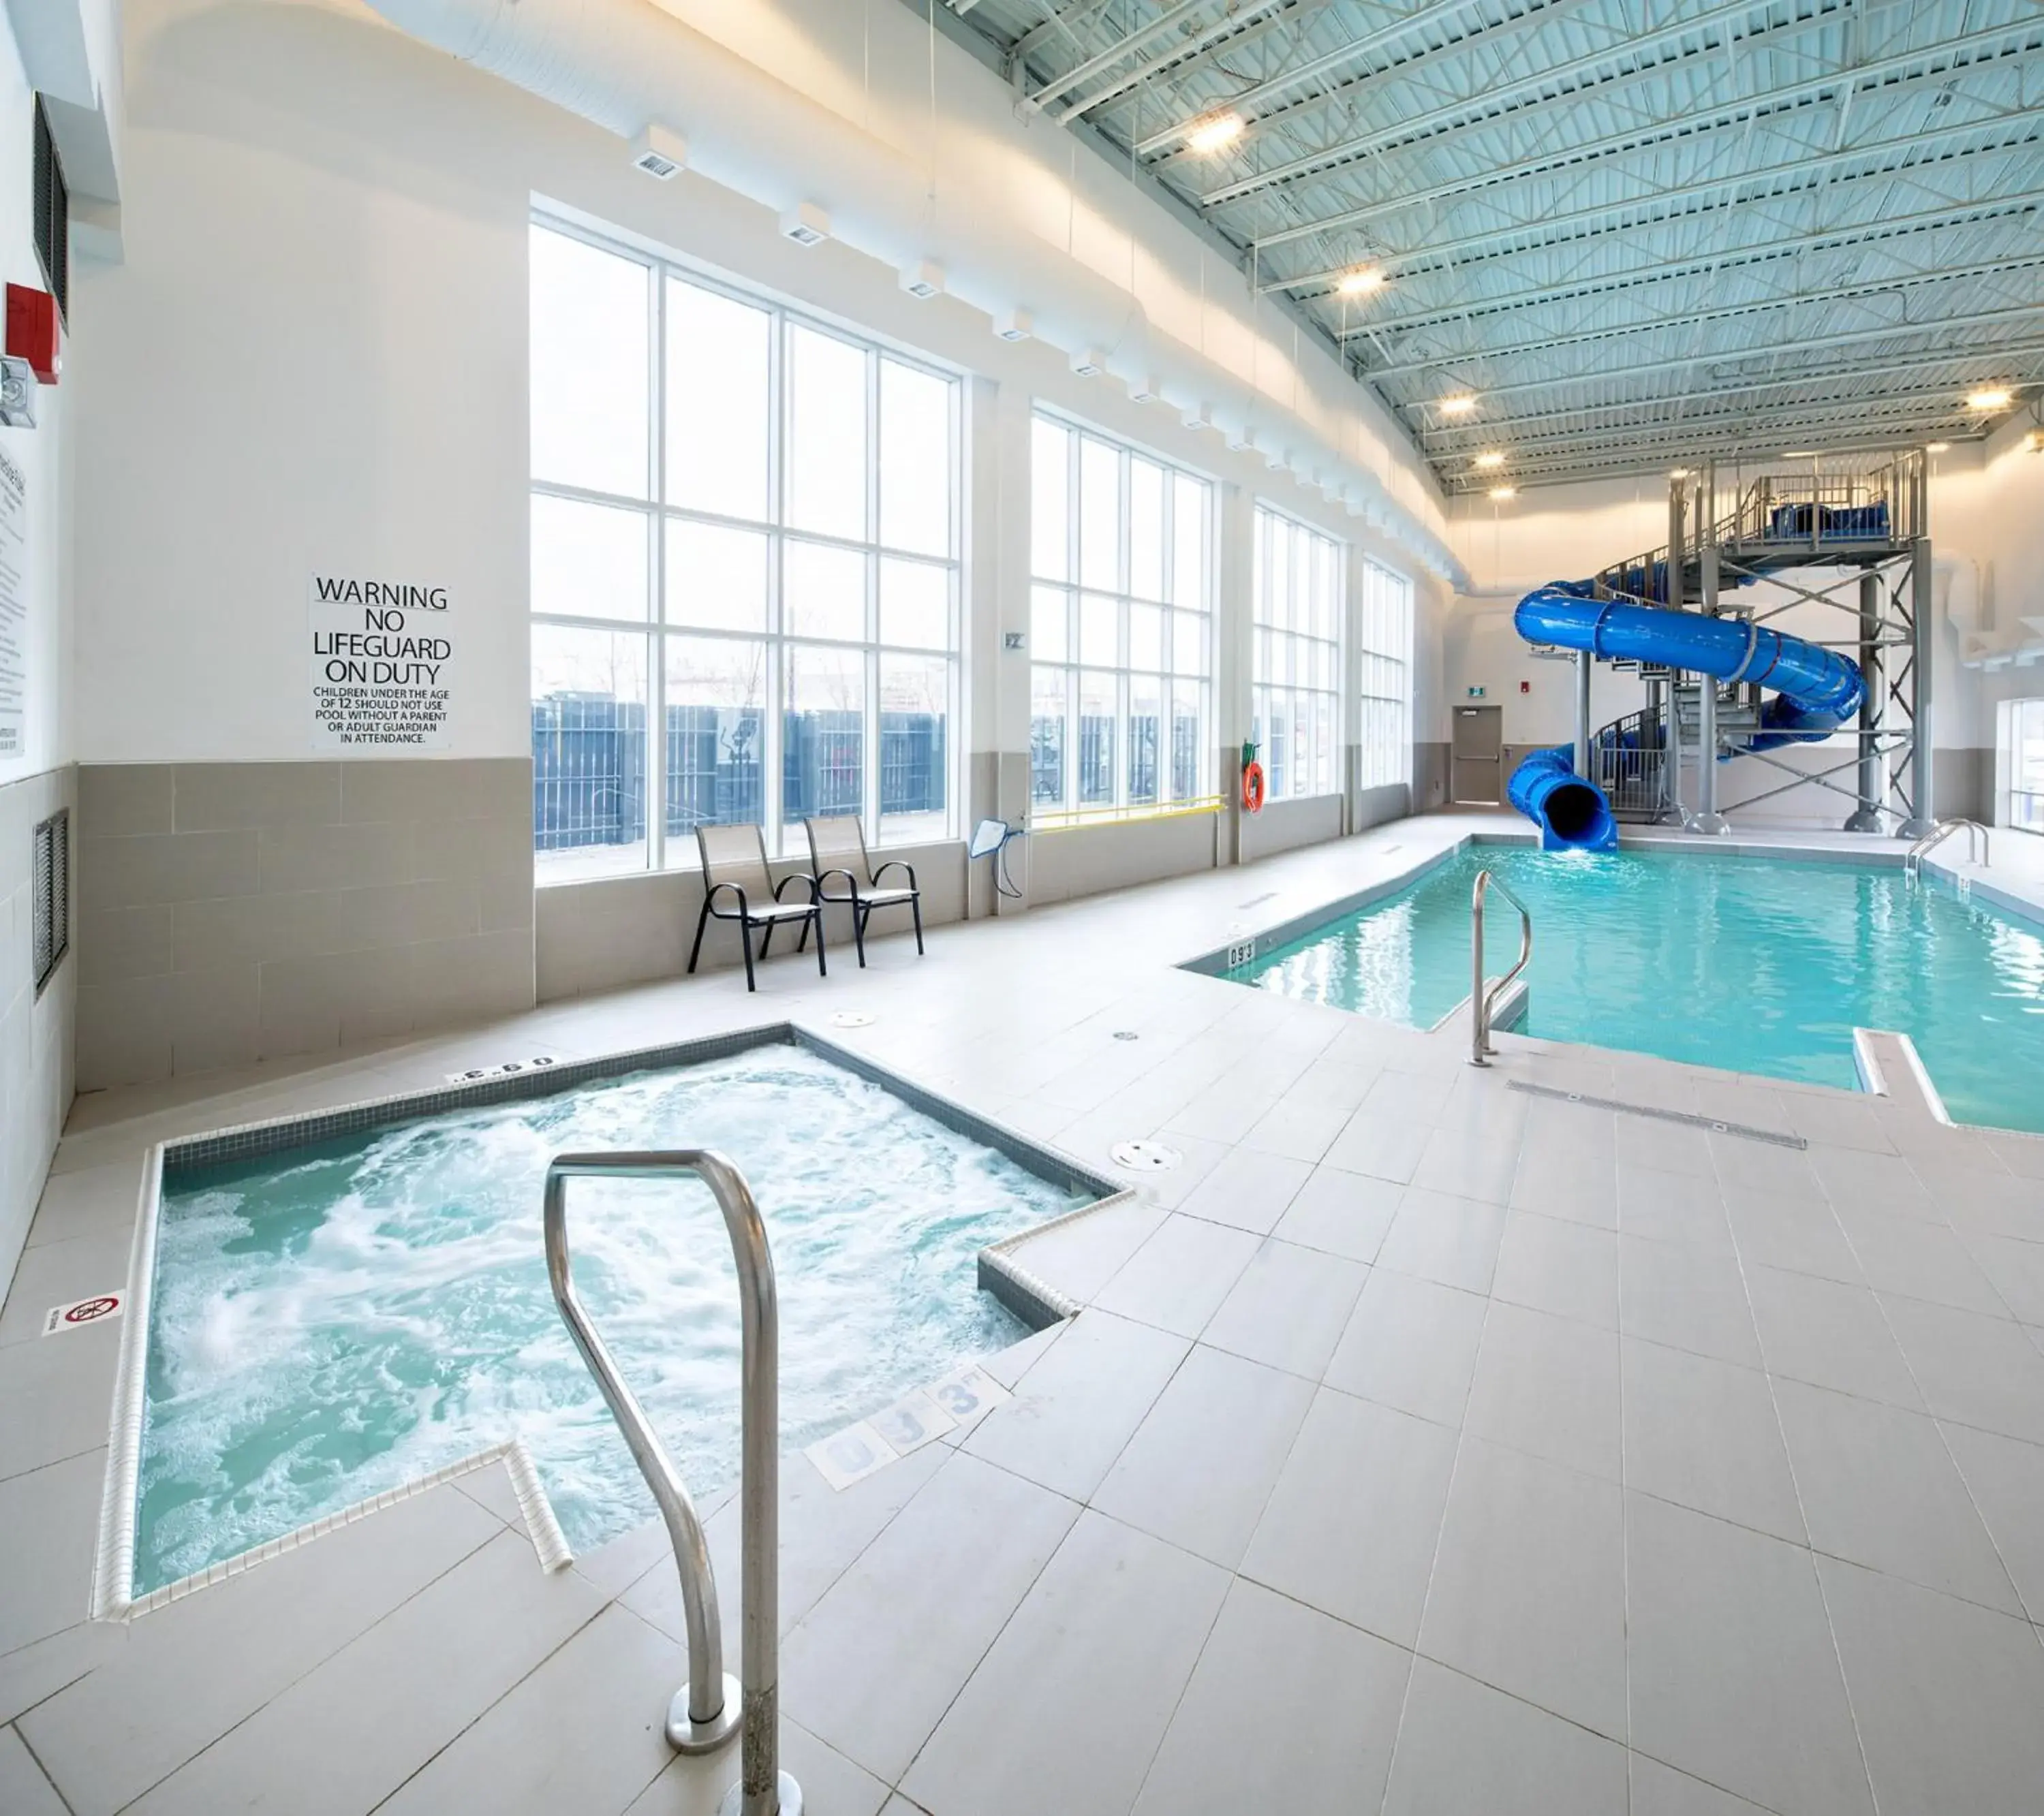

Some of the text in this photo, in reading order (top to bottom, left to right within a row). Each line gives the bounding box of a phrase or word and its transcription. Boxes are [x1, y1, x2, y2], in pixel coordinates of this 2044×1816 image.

[316, 578, 446, 609] WARNING
[366, 608, 404, 631] NO
[314, 632, 450, 660] LIFEGUARD
[326, 659, 440, 685] ON DUTY
[313, 687, 450, 699] CHILDREN UNDER THE AGE
[321, 698, 442, 710] OF 12 SHOULD NOT USE
[316, 710, 346, 719] POOL
[349, 711, 398, 720] WITHOUT
[409, 713, 447, 721] PARENT
[328, 723, 437, 732] OR ADULT GUARDIAN
[341, 734, 425, 743] IN ATTENDANCE.
